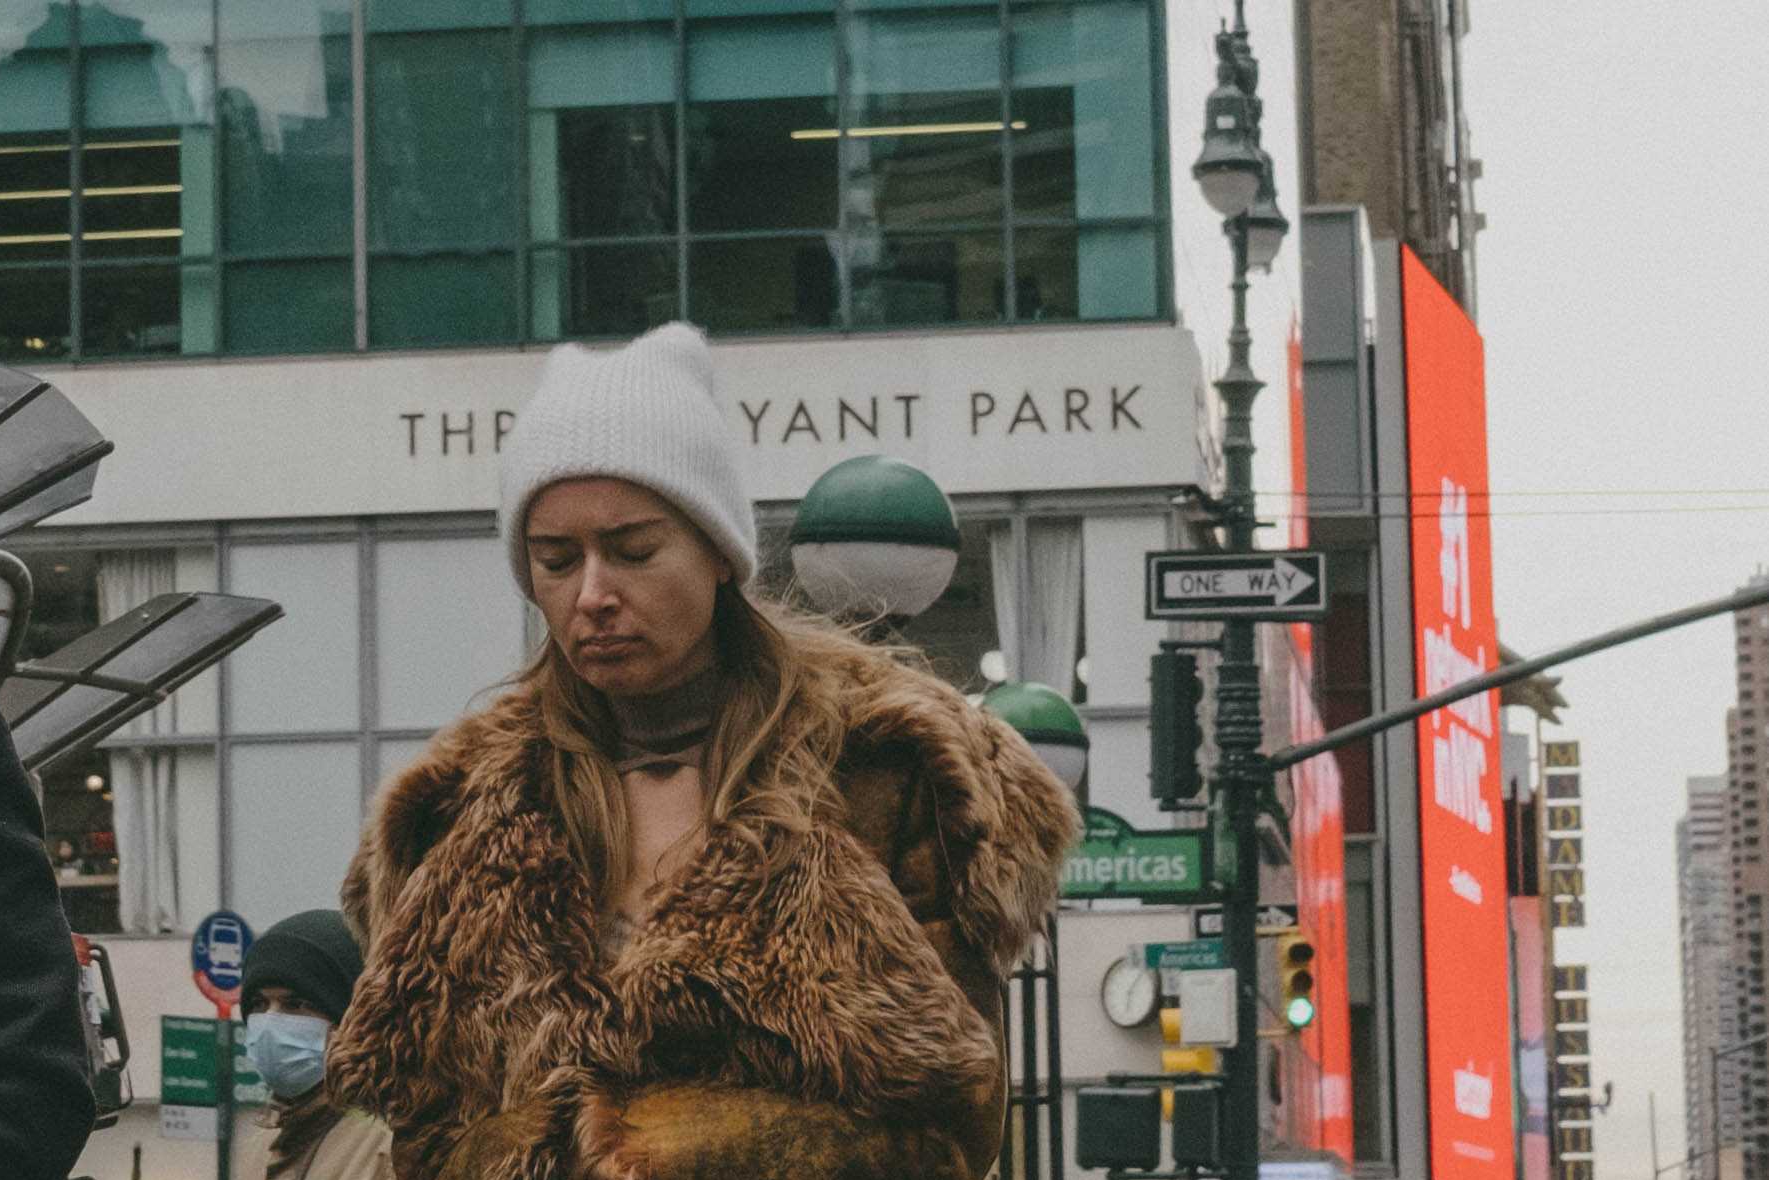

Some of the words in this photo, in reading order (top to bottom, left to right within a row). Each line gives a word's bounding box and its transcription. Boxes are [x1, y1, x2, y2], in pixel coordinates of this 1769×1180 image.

[971, 385, 1143, 435] PARK
[1179, 574, 1224, 594] ONE
[1247, 572, 1297, 592] WAY
